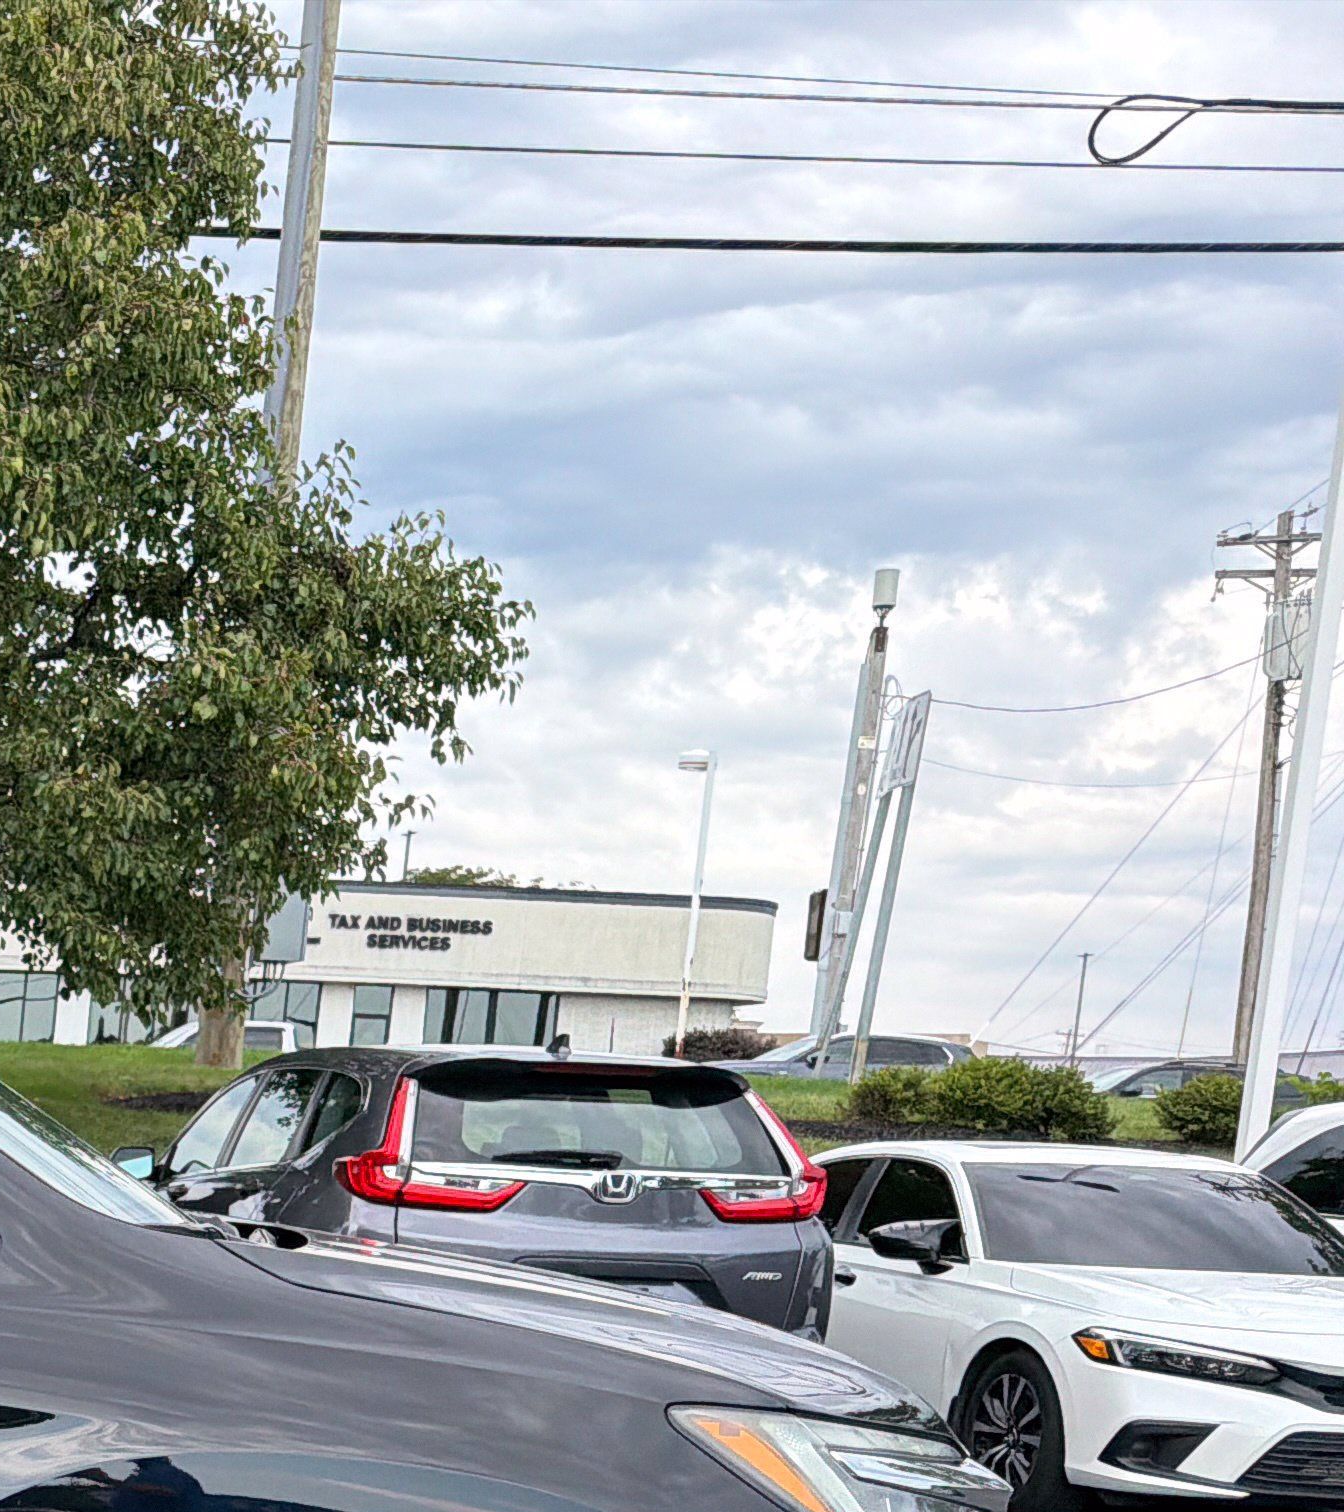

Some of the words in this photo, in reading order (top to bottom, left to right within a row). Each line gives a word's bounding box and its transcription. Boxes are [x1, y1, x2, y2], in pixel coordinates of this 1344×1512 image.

[328, 913, 362, 929] TAX
[364, 915, 402, 931] AND
[406, 917, 494, 935] BUSINESS
[366, 933, 452, 951] SERVICES
